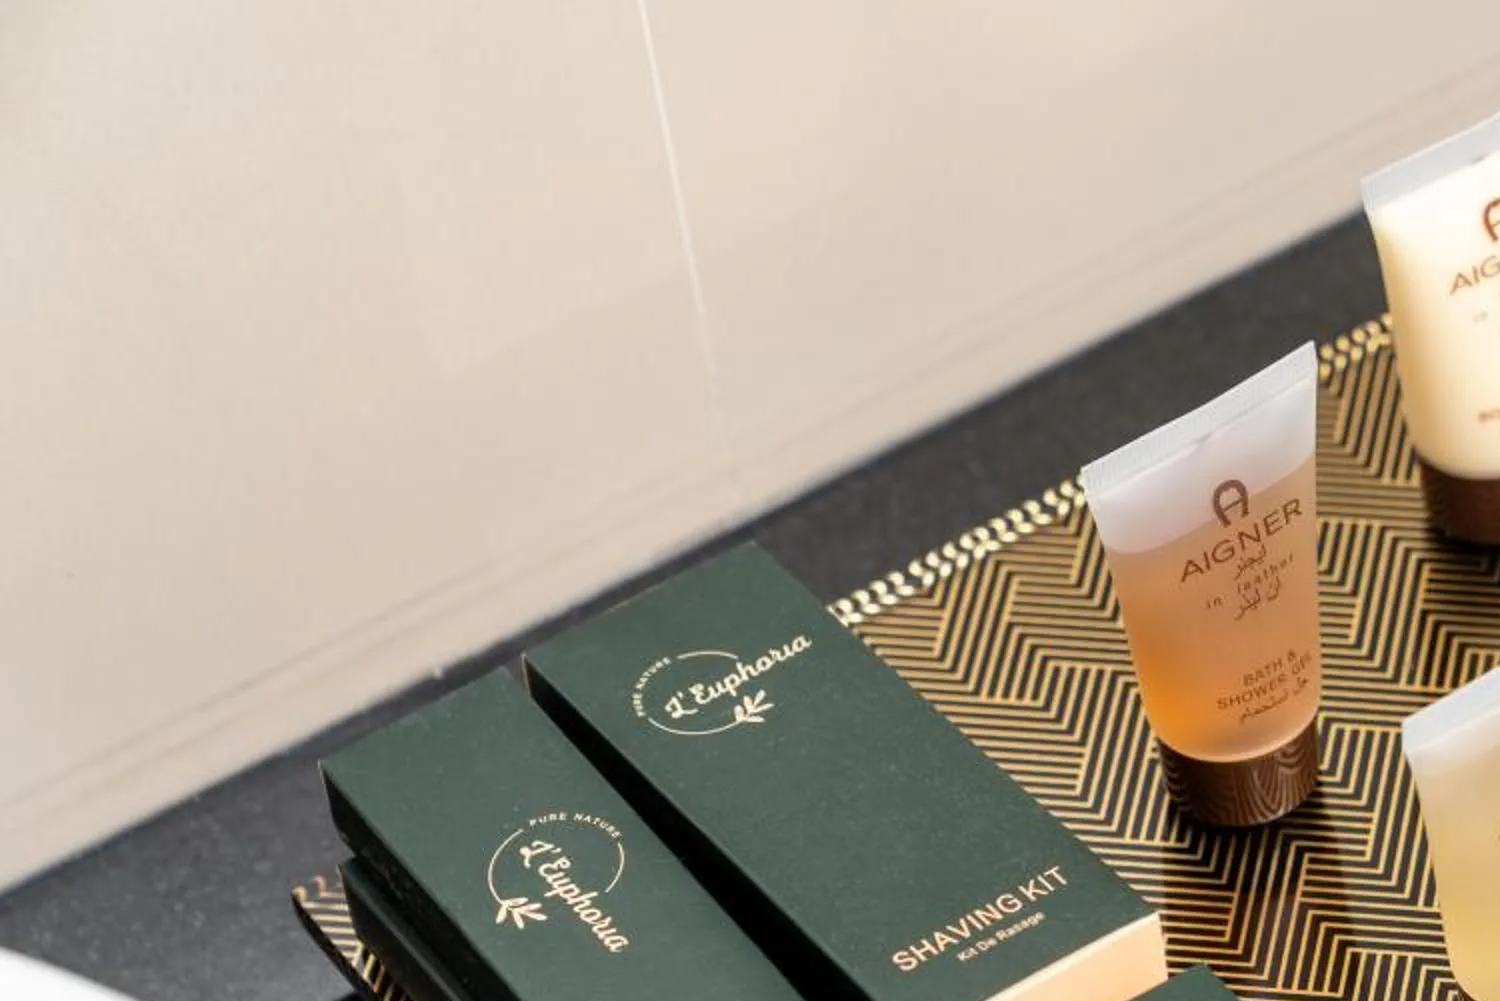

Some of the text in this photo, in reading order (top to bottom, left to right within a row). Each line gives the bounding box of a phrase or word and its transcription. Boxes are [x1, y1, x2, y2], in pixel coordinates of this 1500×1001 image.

[1180, 498, 1304, 583] AIGNER
[664, 634, 812, 719] L'Euphoria
[1217, 673, 1288, 710] SHOWER
[1243, 658, 1282, 687] BATH
[529, 812, 623, 839] PURE NATURE
[519, 840, 629, 953] L'Euphoria
[892, 865, 1068, 971] SHAVING KIT
[957, 947, 979, 962] Kit
[975, 938, 998, 951] De
